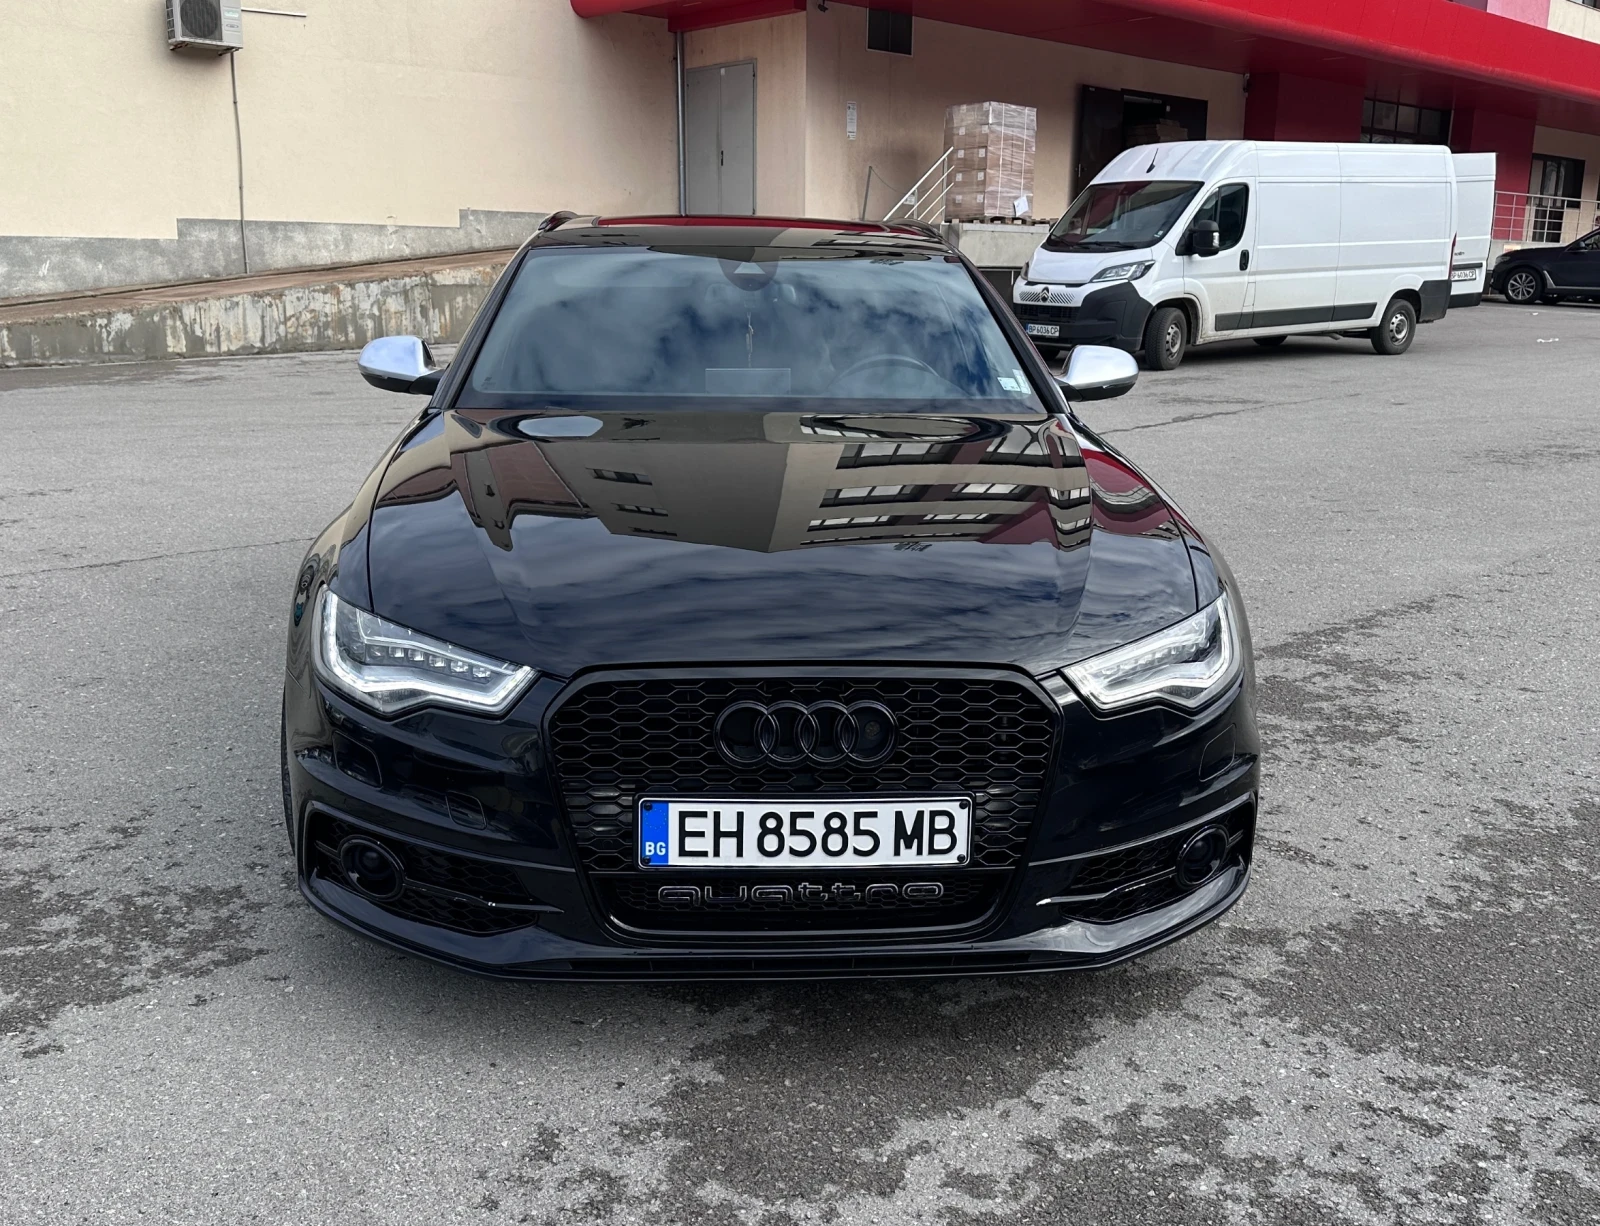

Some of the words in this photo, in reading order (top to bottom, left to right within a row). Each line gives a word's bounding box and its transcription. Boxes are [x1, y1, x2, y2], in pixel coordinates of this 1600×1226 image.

[1457, 271, 1468, 279] 6036
[1028, 325, 1036, 333] BP
[1050, 326, 1059, 335] CP
[678, 810, 745, 858] EH
[756, 811, 881, 858] 8585
[893, 809, 958, 857] MB
[645, 841, 667, 856] BG
[657, 882, 945, 906] quattro
